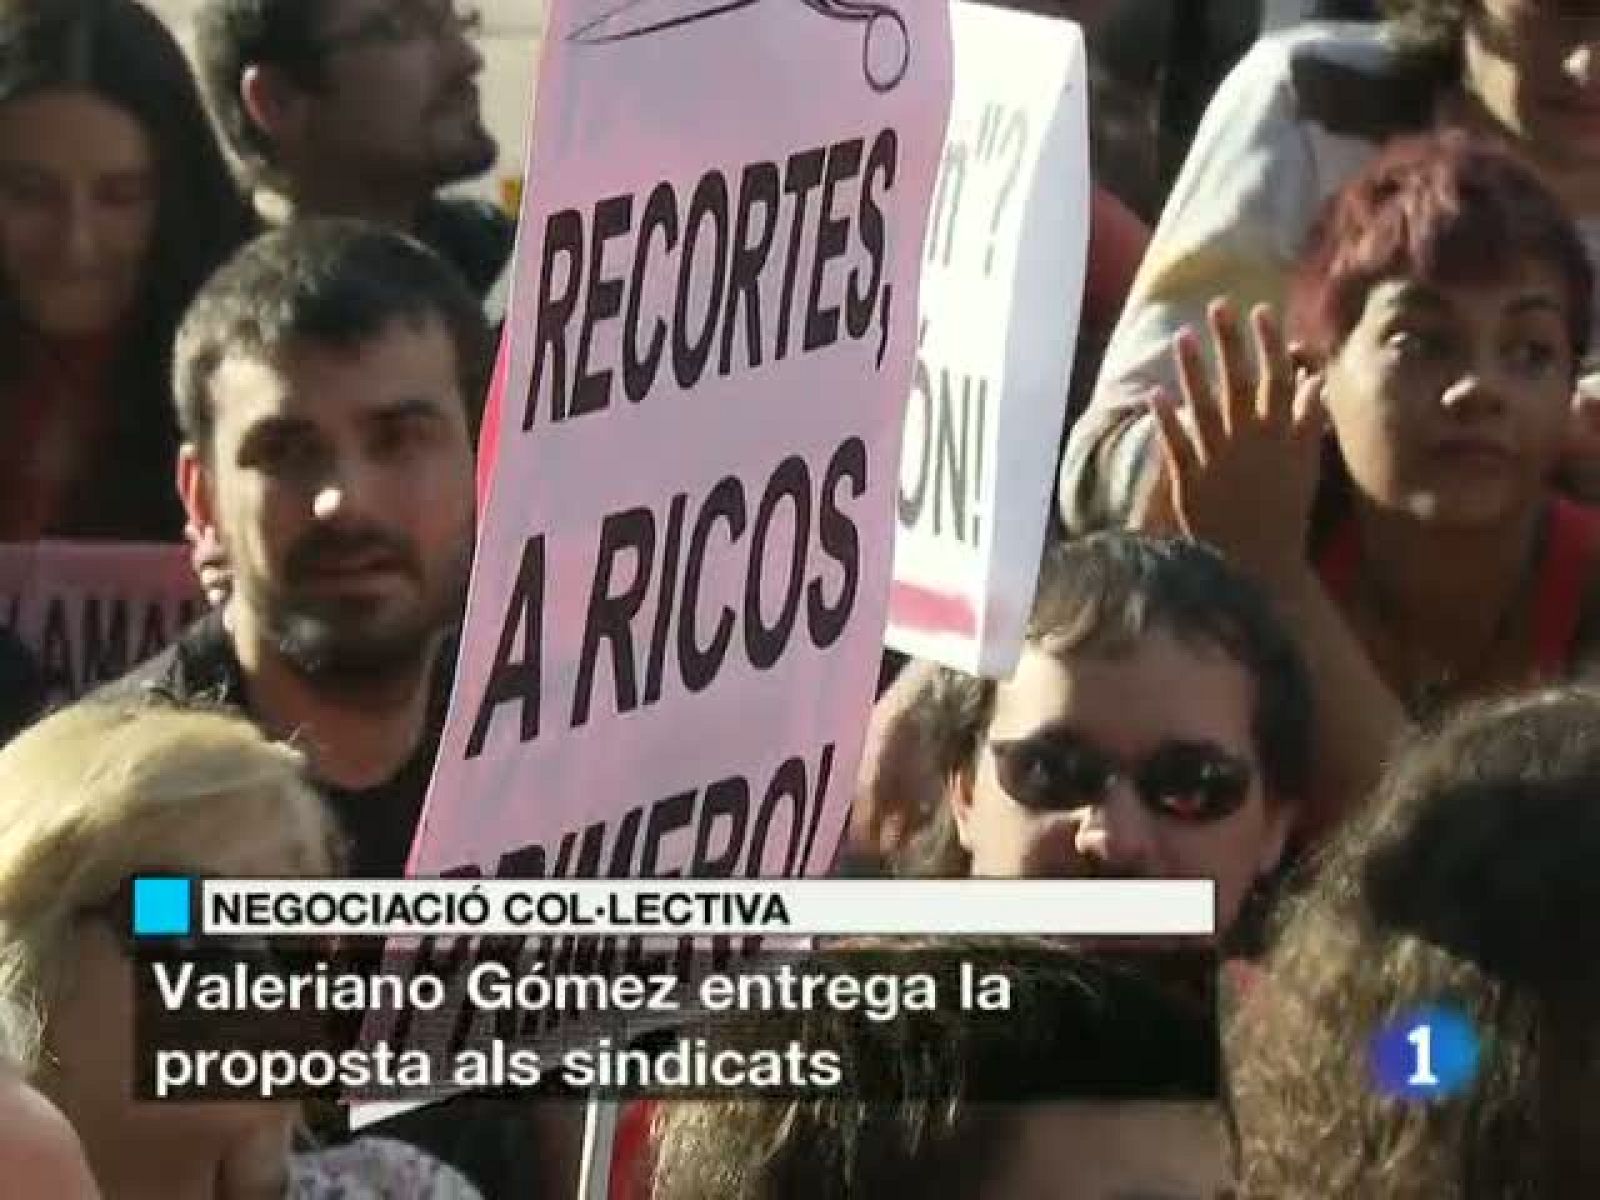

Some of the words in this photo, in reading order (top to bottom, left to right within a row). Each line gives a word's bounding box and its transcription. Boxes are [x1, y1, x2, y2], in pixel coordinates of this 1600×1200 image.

[522, 127, 897, 431] RECORTES,
[465, 533, 545, 760] A
[569, 436, 867, 728] RICOS
